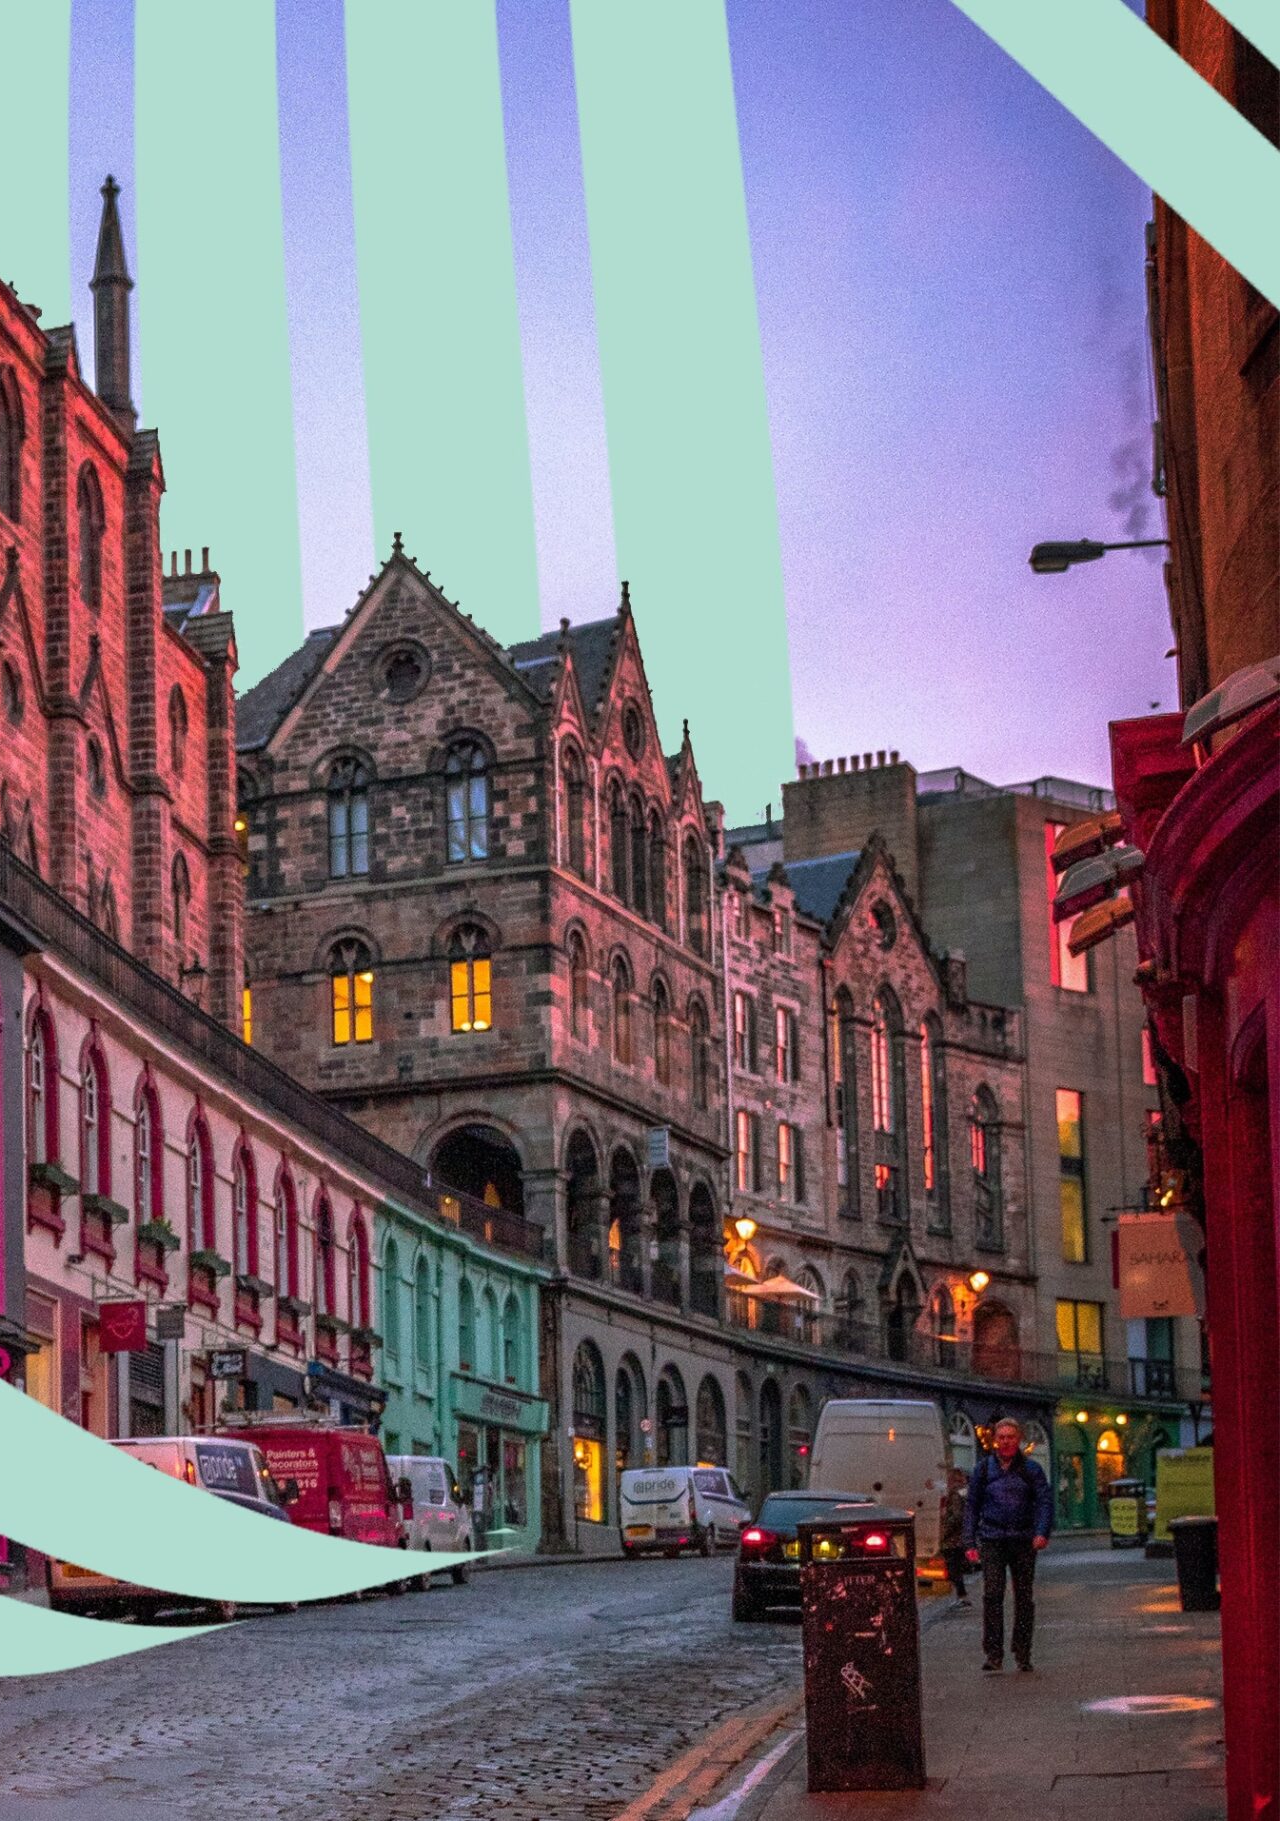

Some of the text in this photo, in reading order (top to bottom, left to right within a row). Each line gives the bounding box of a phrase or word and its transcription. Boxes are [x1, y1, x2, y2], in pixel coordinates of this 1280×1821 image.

[266, 1447, 316, 1460] Painters &
[633, 1478, 675, 1494] @pride
